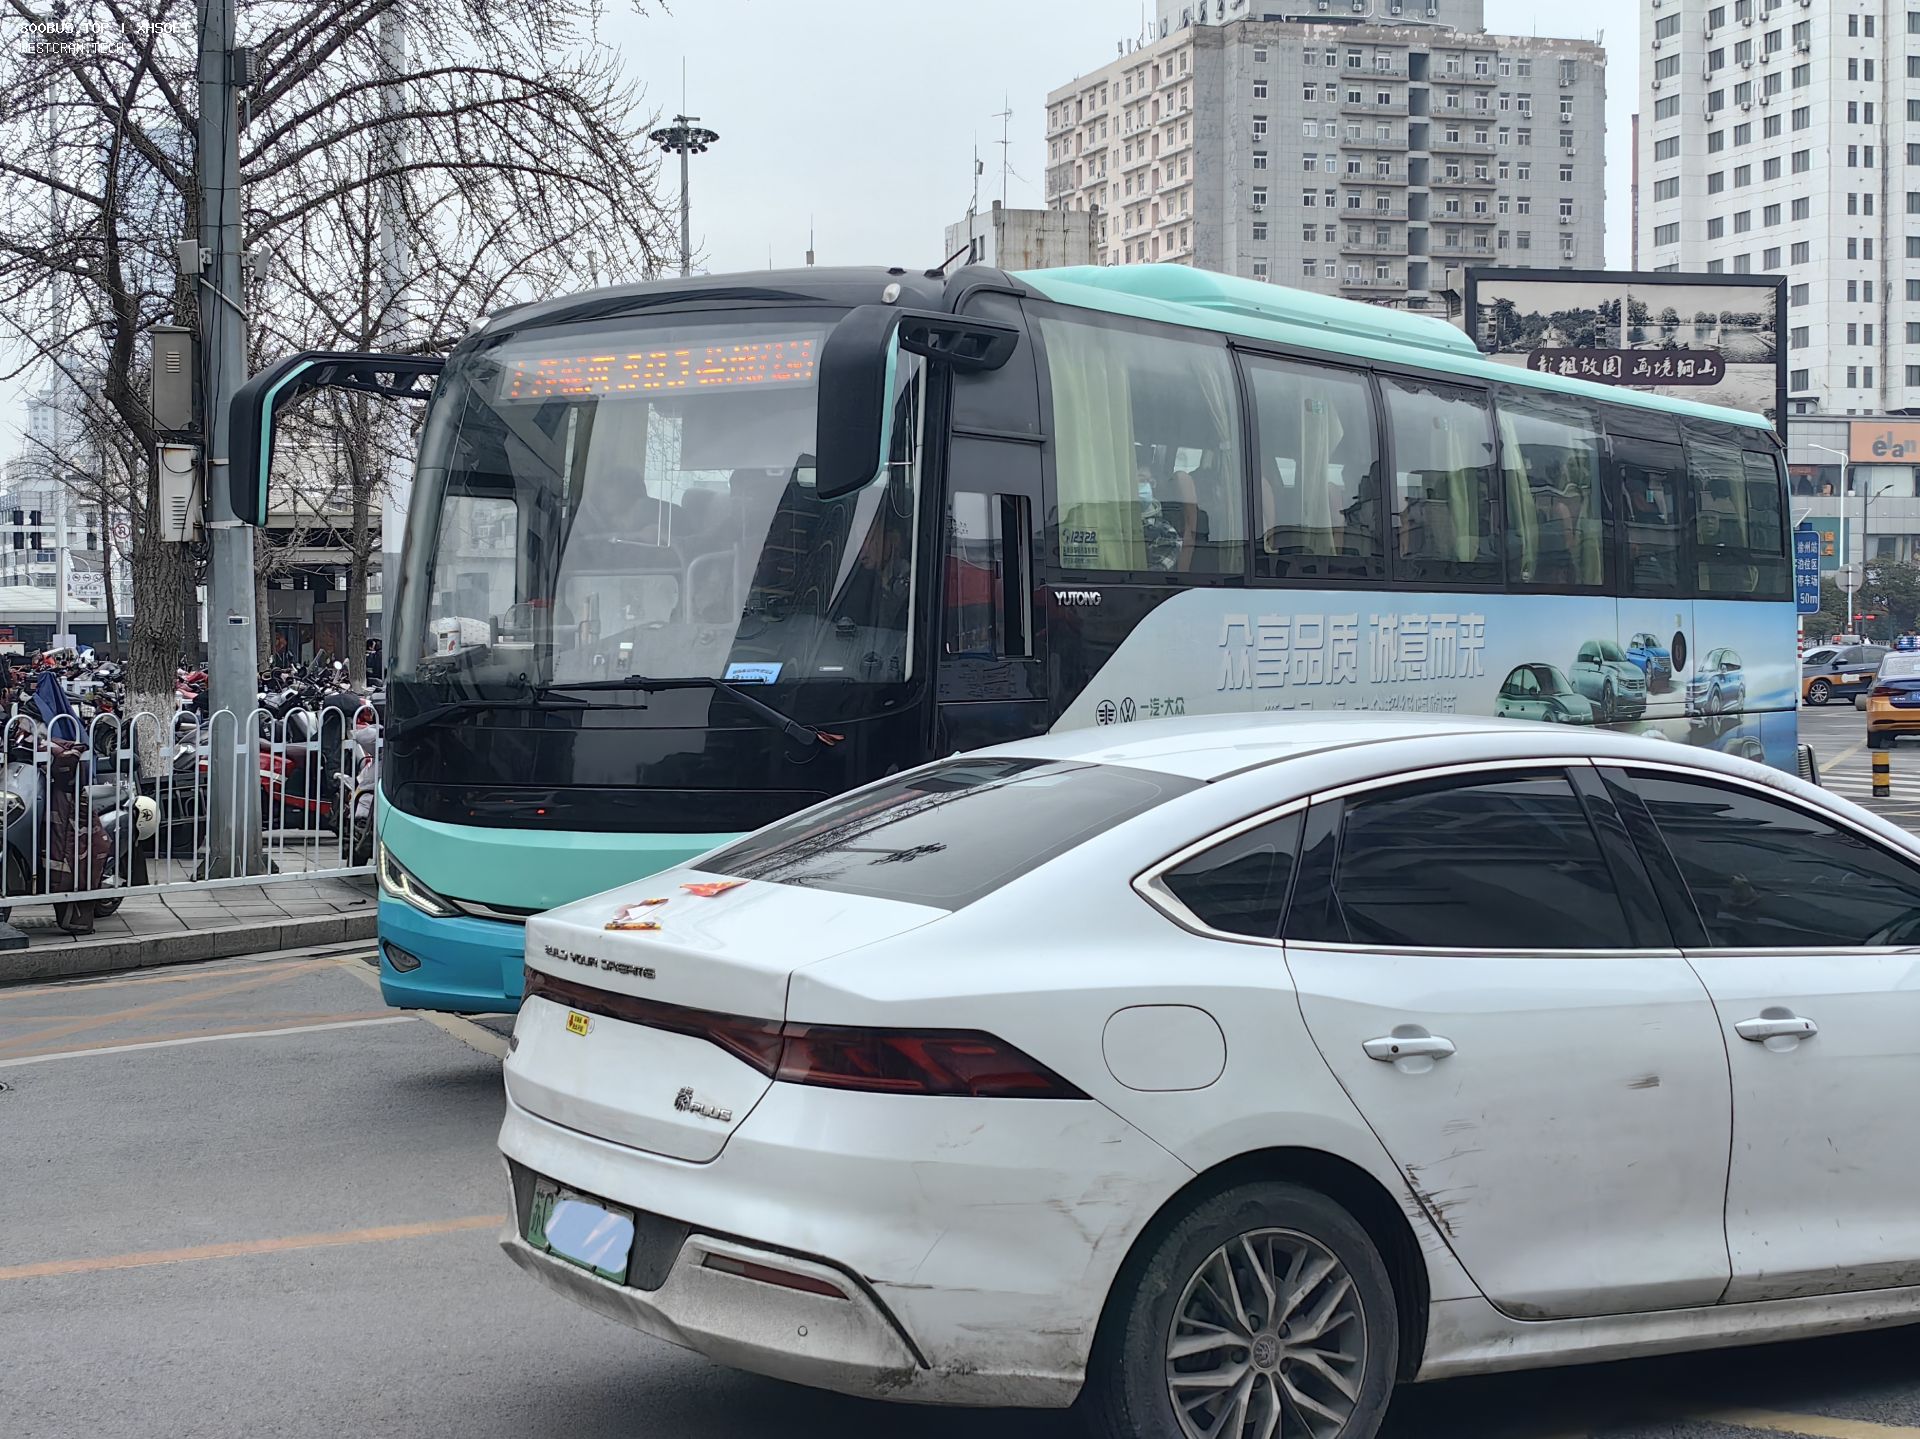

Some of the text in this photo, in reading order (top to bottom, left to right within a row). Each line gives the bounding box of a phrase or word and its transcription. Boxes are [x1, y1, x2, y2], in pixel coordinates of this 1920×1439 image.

[1054, 591, 1102, 606] YUTONG
[1217, 612, 1487, 691] 众享品质 诚意而来
[569, 952, 598, 968] YOUR
[689, 1102, 732, 1122] PLUS
